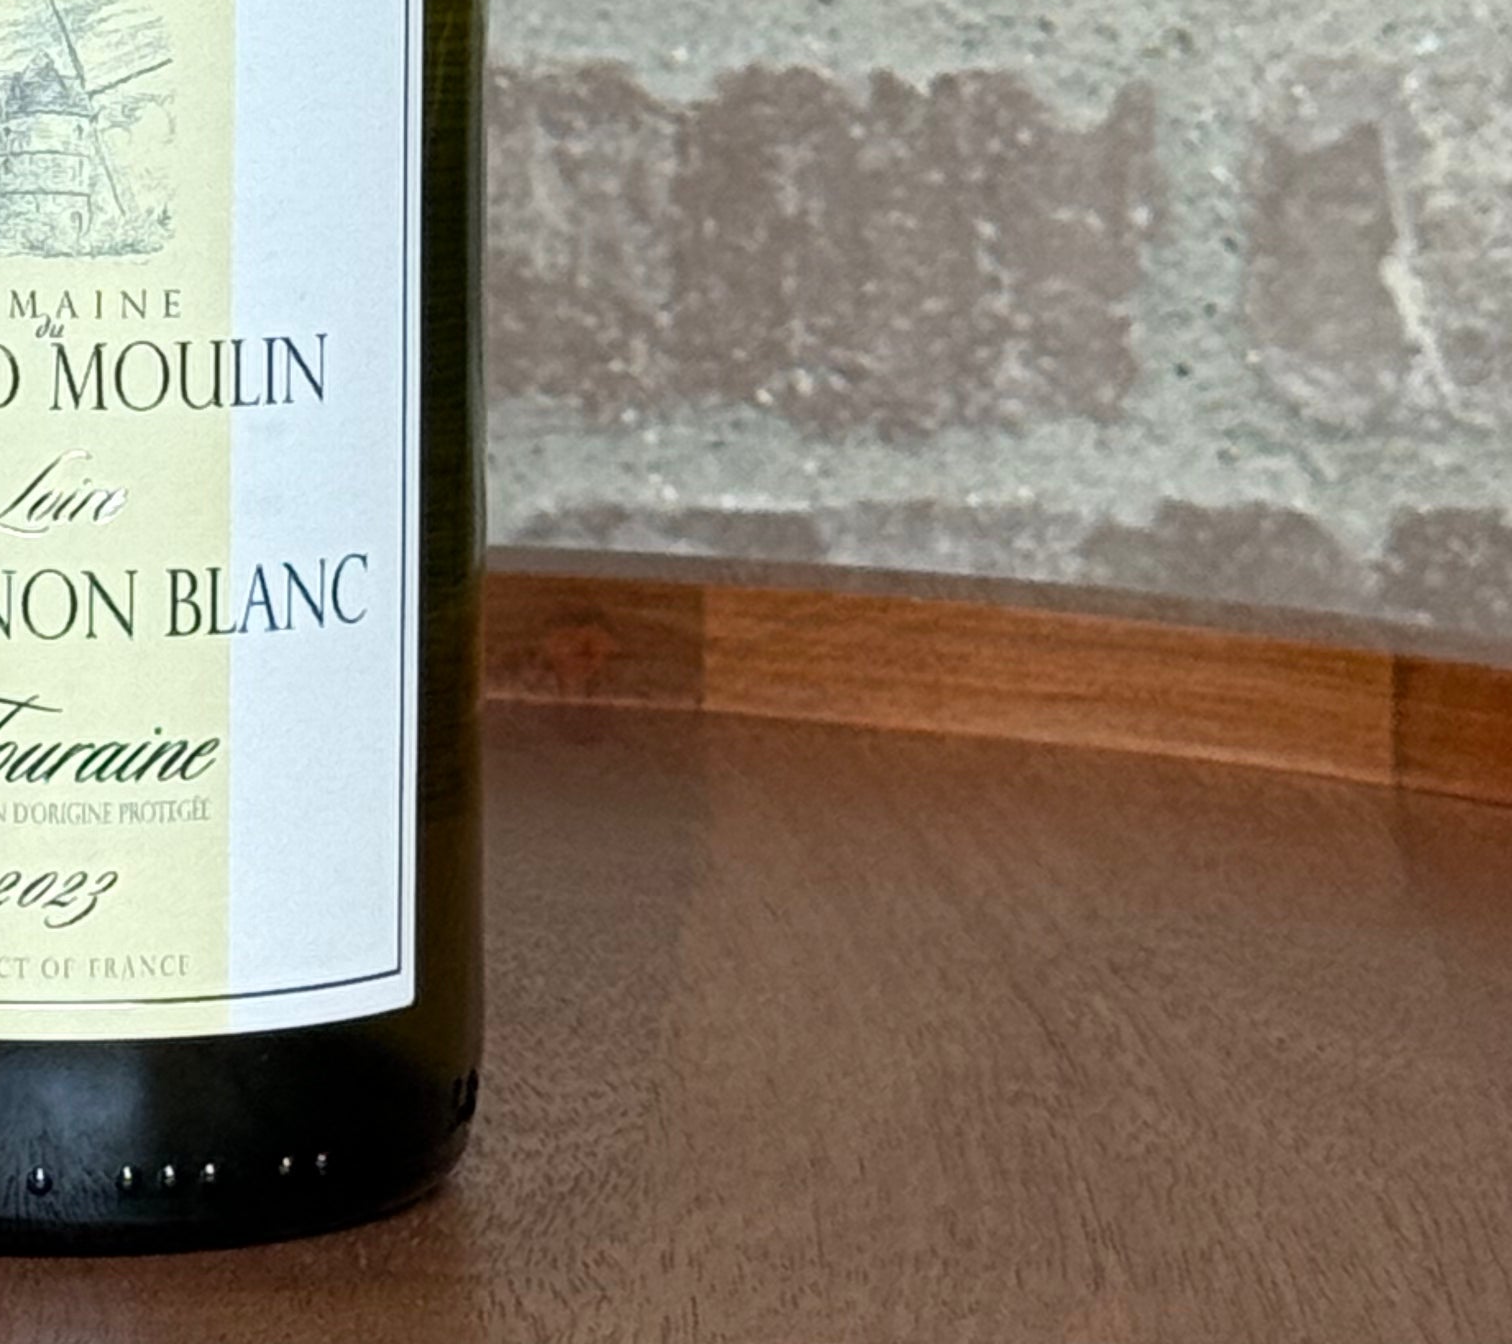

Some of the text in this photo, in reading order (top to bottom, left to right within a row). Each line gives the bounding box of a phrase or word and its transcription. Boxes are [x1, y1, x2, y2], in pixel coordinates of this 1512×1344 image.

[35, 314, 65, 340] du
[50, 333, 328, 411] MOULIN
[165, 553, 370, 638] BLANC
[42, 955, 74, 980] OF
[88, 953, 191, 980] FRANCE
